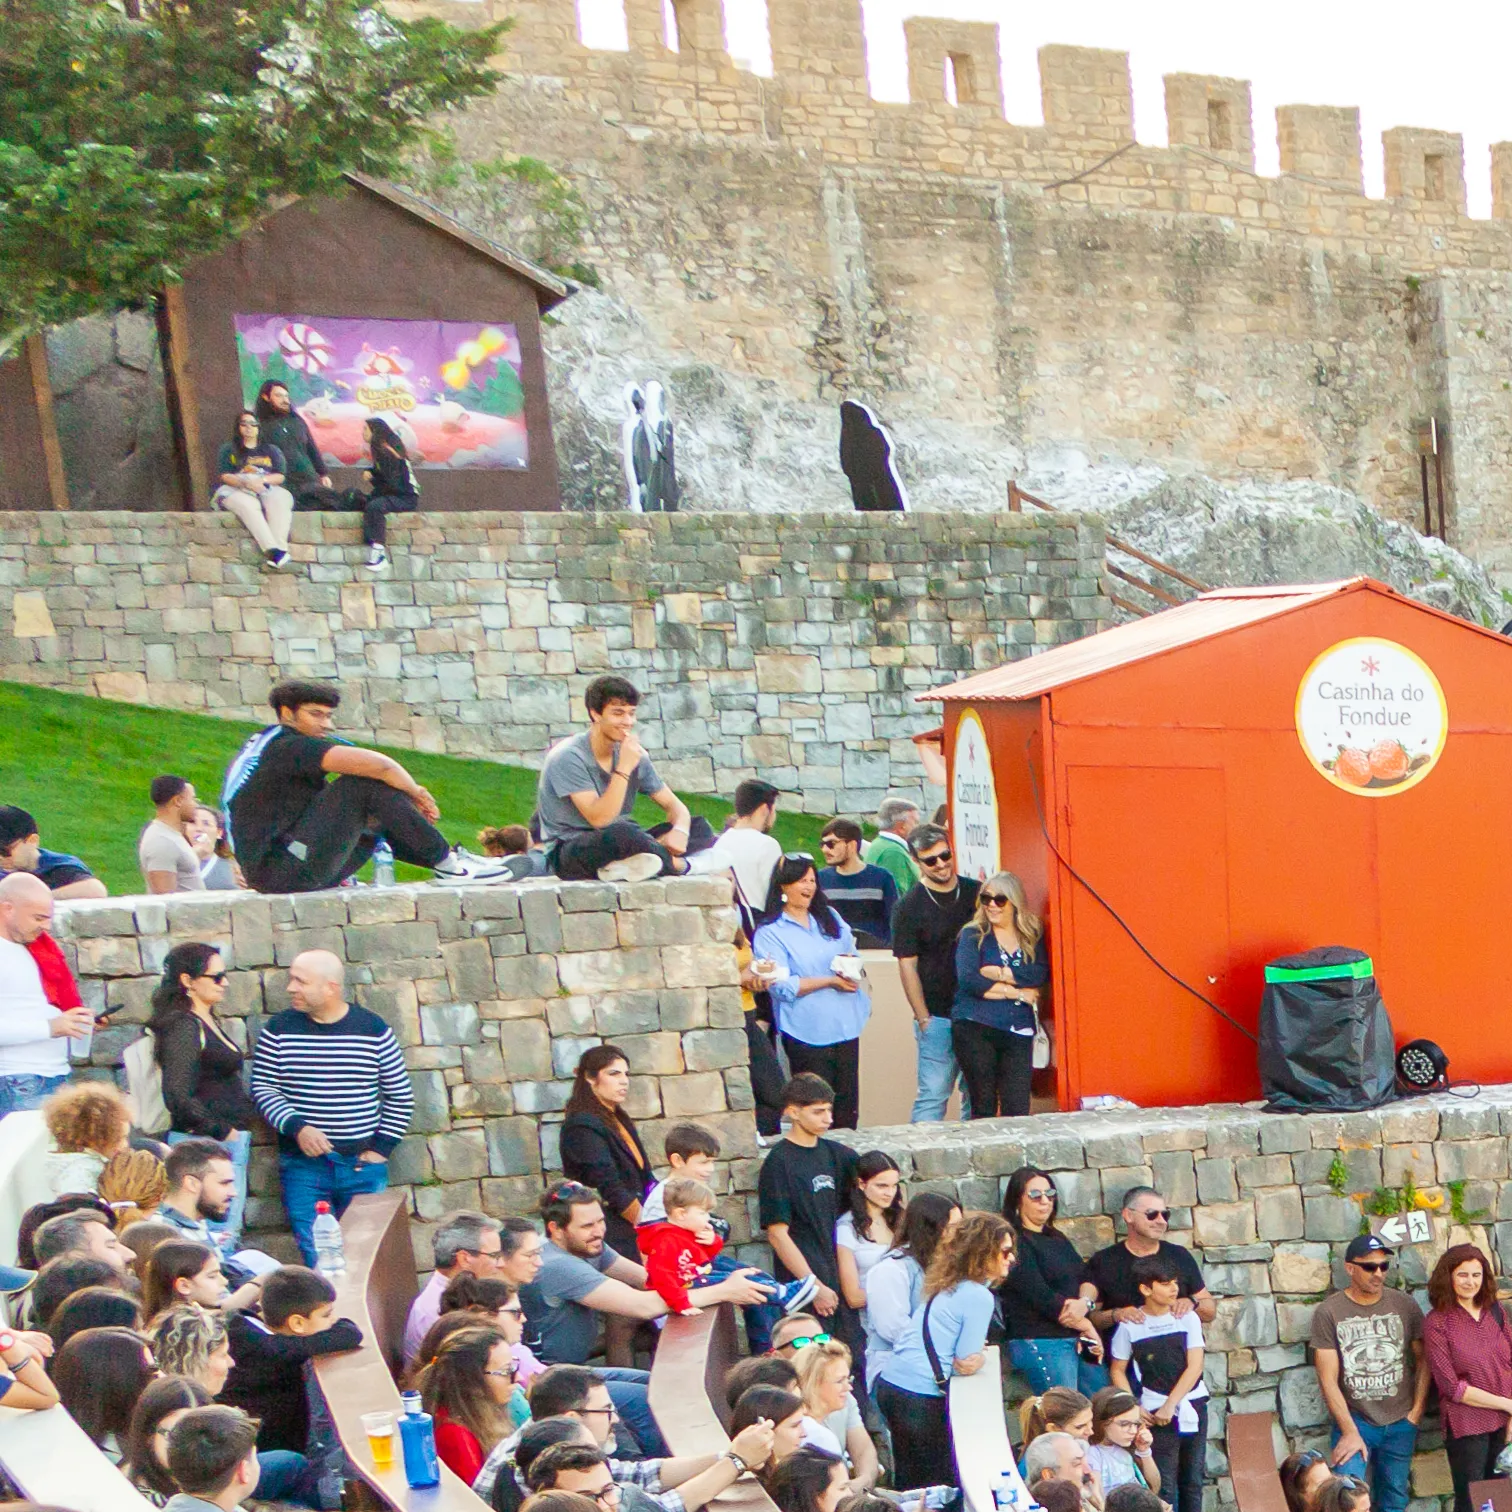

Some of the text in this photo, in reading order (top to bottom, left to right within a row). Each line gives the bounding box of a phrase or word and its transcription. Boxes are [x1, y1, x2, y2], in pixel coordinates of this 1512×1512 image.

[1318, 681, 1424, 701] Casinha do
[1338, 705, 1411, 726] Fondue
